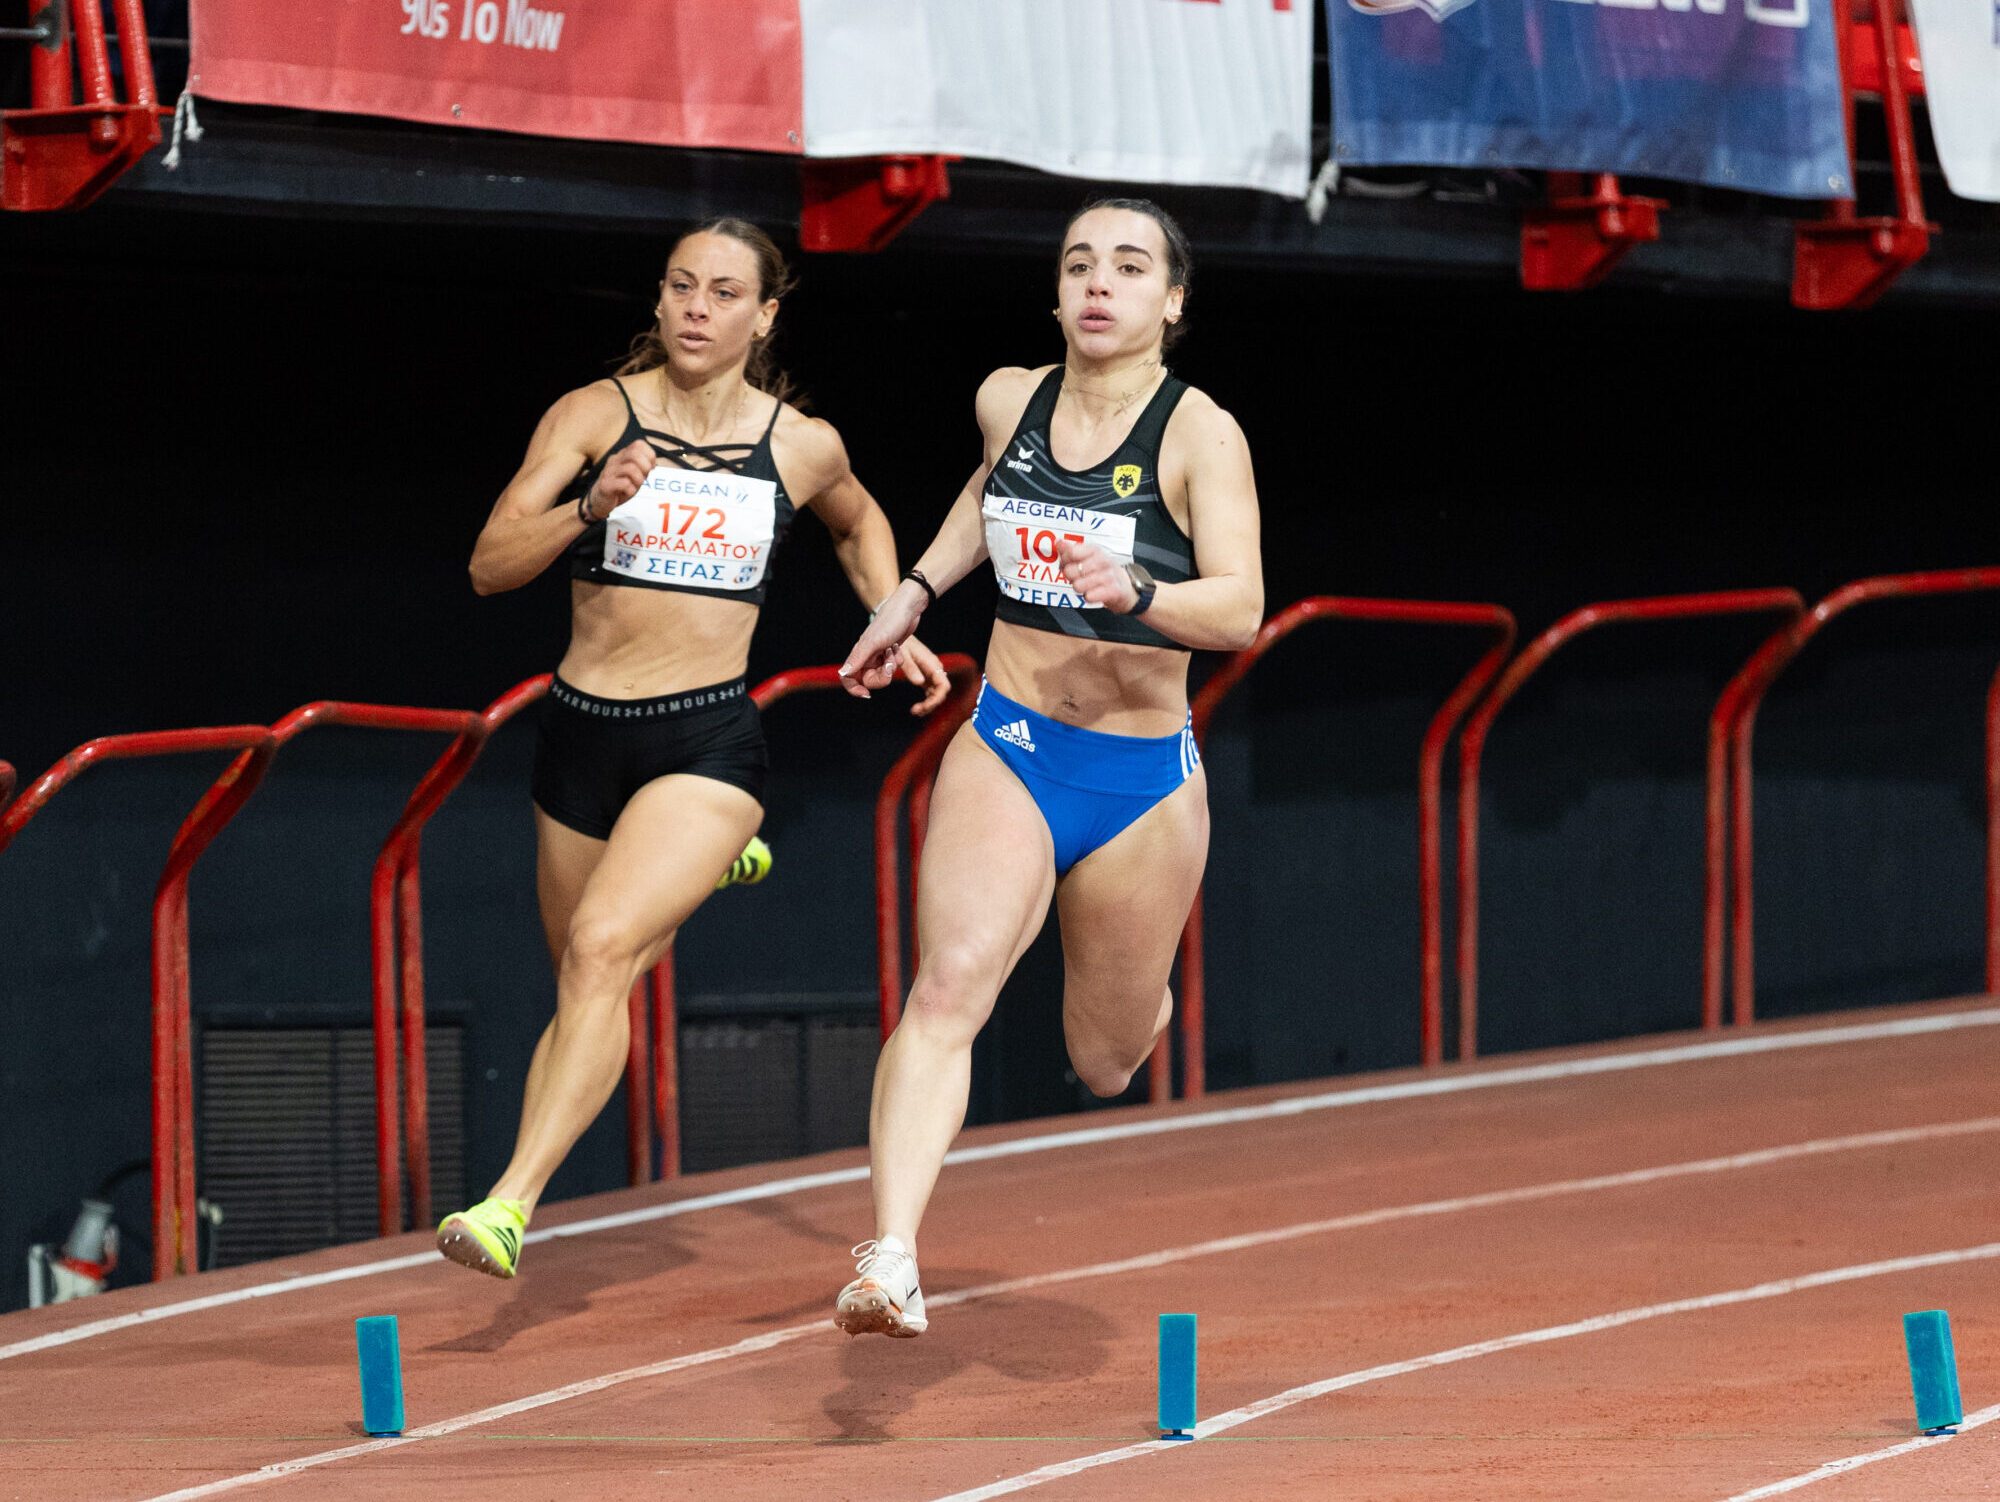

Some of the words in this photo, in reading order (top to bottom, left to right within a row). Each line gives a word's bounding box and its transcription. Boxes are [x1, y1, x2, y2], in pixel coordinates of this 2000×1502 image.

[504, 0, 565, 50] Now
[658, 502, 726, 539] 172
[1002, 500, 1084, 522] AEGEAN
[616, 529, 761, 559] ΚΑΡΚΑΛΑΤΟΥ
[647, 557, 725, 580] ΣΕΓΑΣ
[1017, 562, 1073, 585] ΖΥΛΑ
[563, 694, 621, 717] ARMOUR
[646, 692, 717, 716] ARMOUR
[994, 728, 1036, 753] adidas
